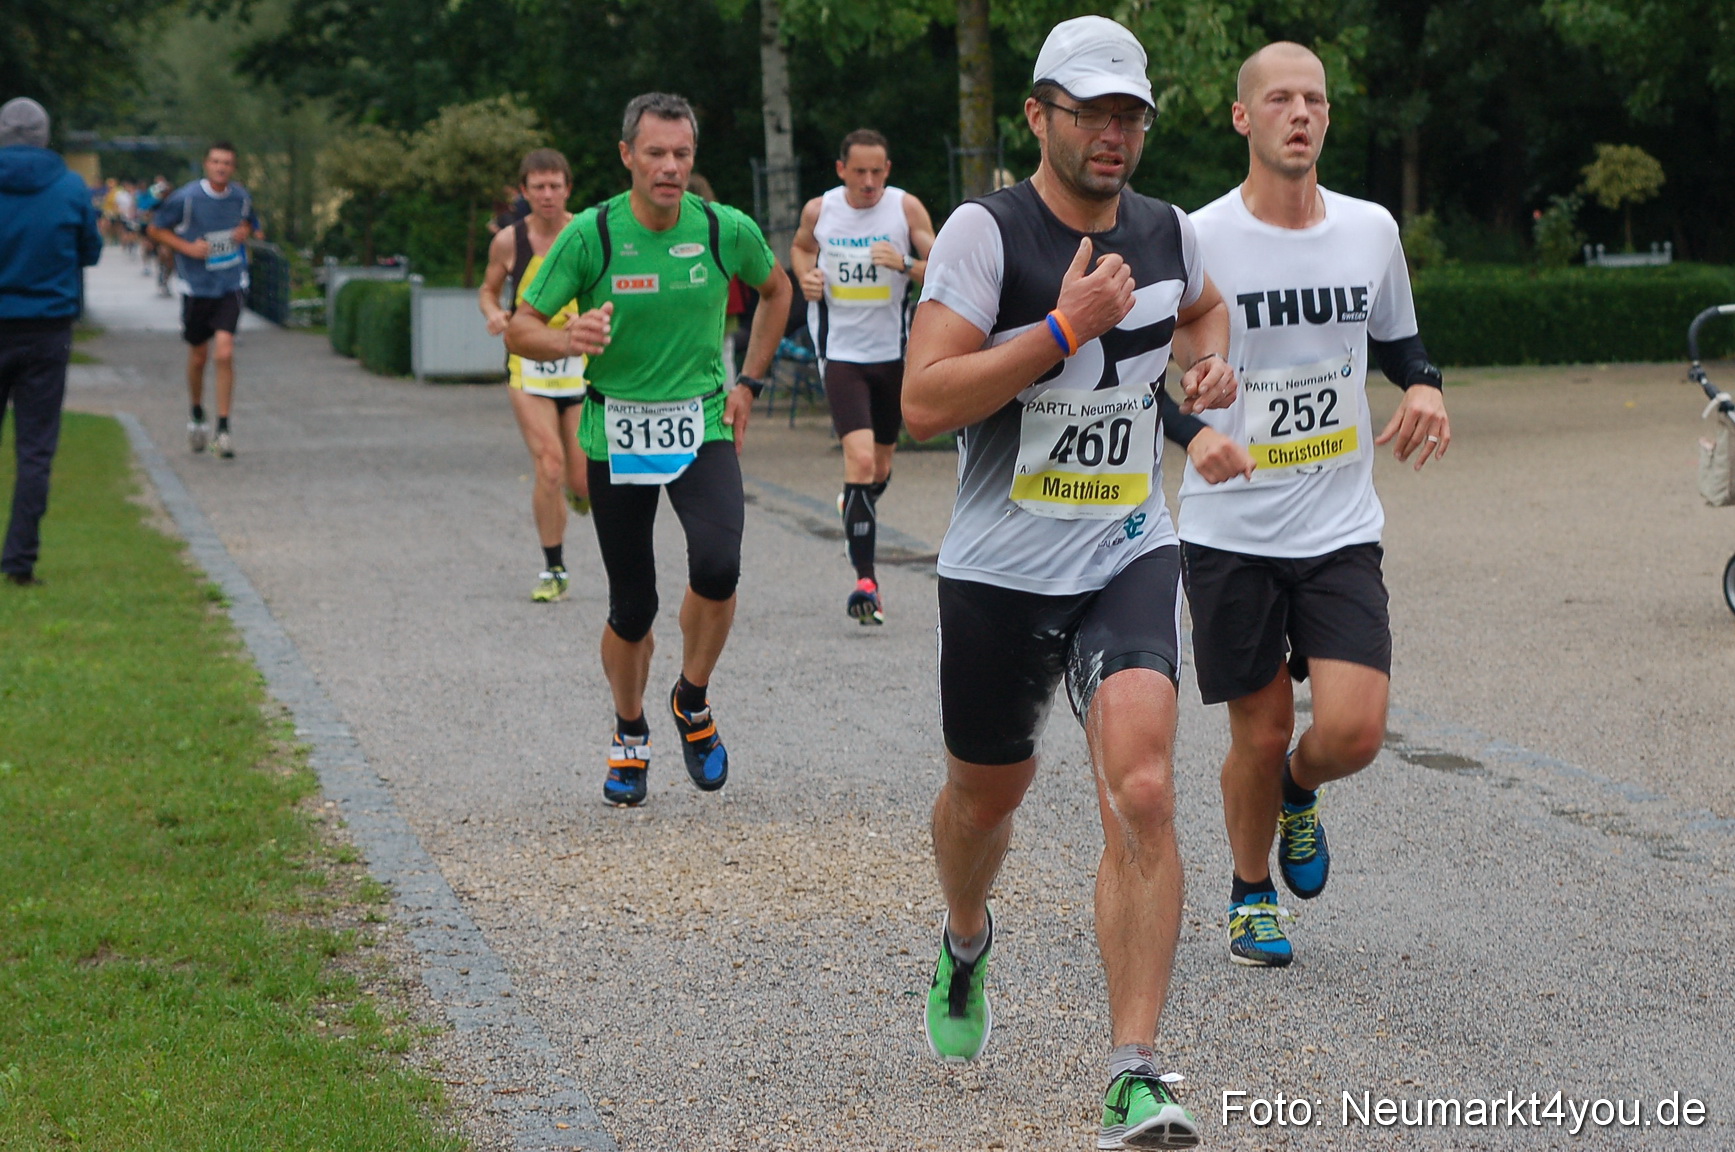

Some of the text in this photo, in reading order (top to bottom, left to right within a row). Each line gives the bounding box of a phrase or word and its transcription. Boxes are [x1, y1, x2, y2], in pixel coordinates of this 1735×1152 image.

[828, 234, 890, 248] SIEMENS
[616, 278, 654, 290] OBI
[839, 262, 878, 283] 544
[1237, 287, 1368, 329] THULE
[1245, 371, 1338, 393] PARTL Neumarkt
[607, 404, 685, 414] PARTL Neumarkt
[1024, 399, 1139, 417] PARTL Neumarkt
[1268, 388, 1340, 438] 252
[616, 417, 695, 449] 3136
[1049, 417, 1133, 467] 460
[1268, 439, 1344, 465] Christoffer
[1042, 476, 1120, 500] Matthias
